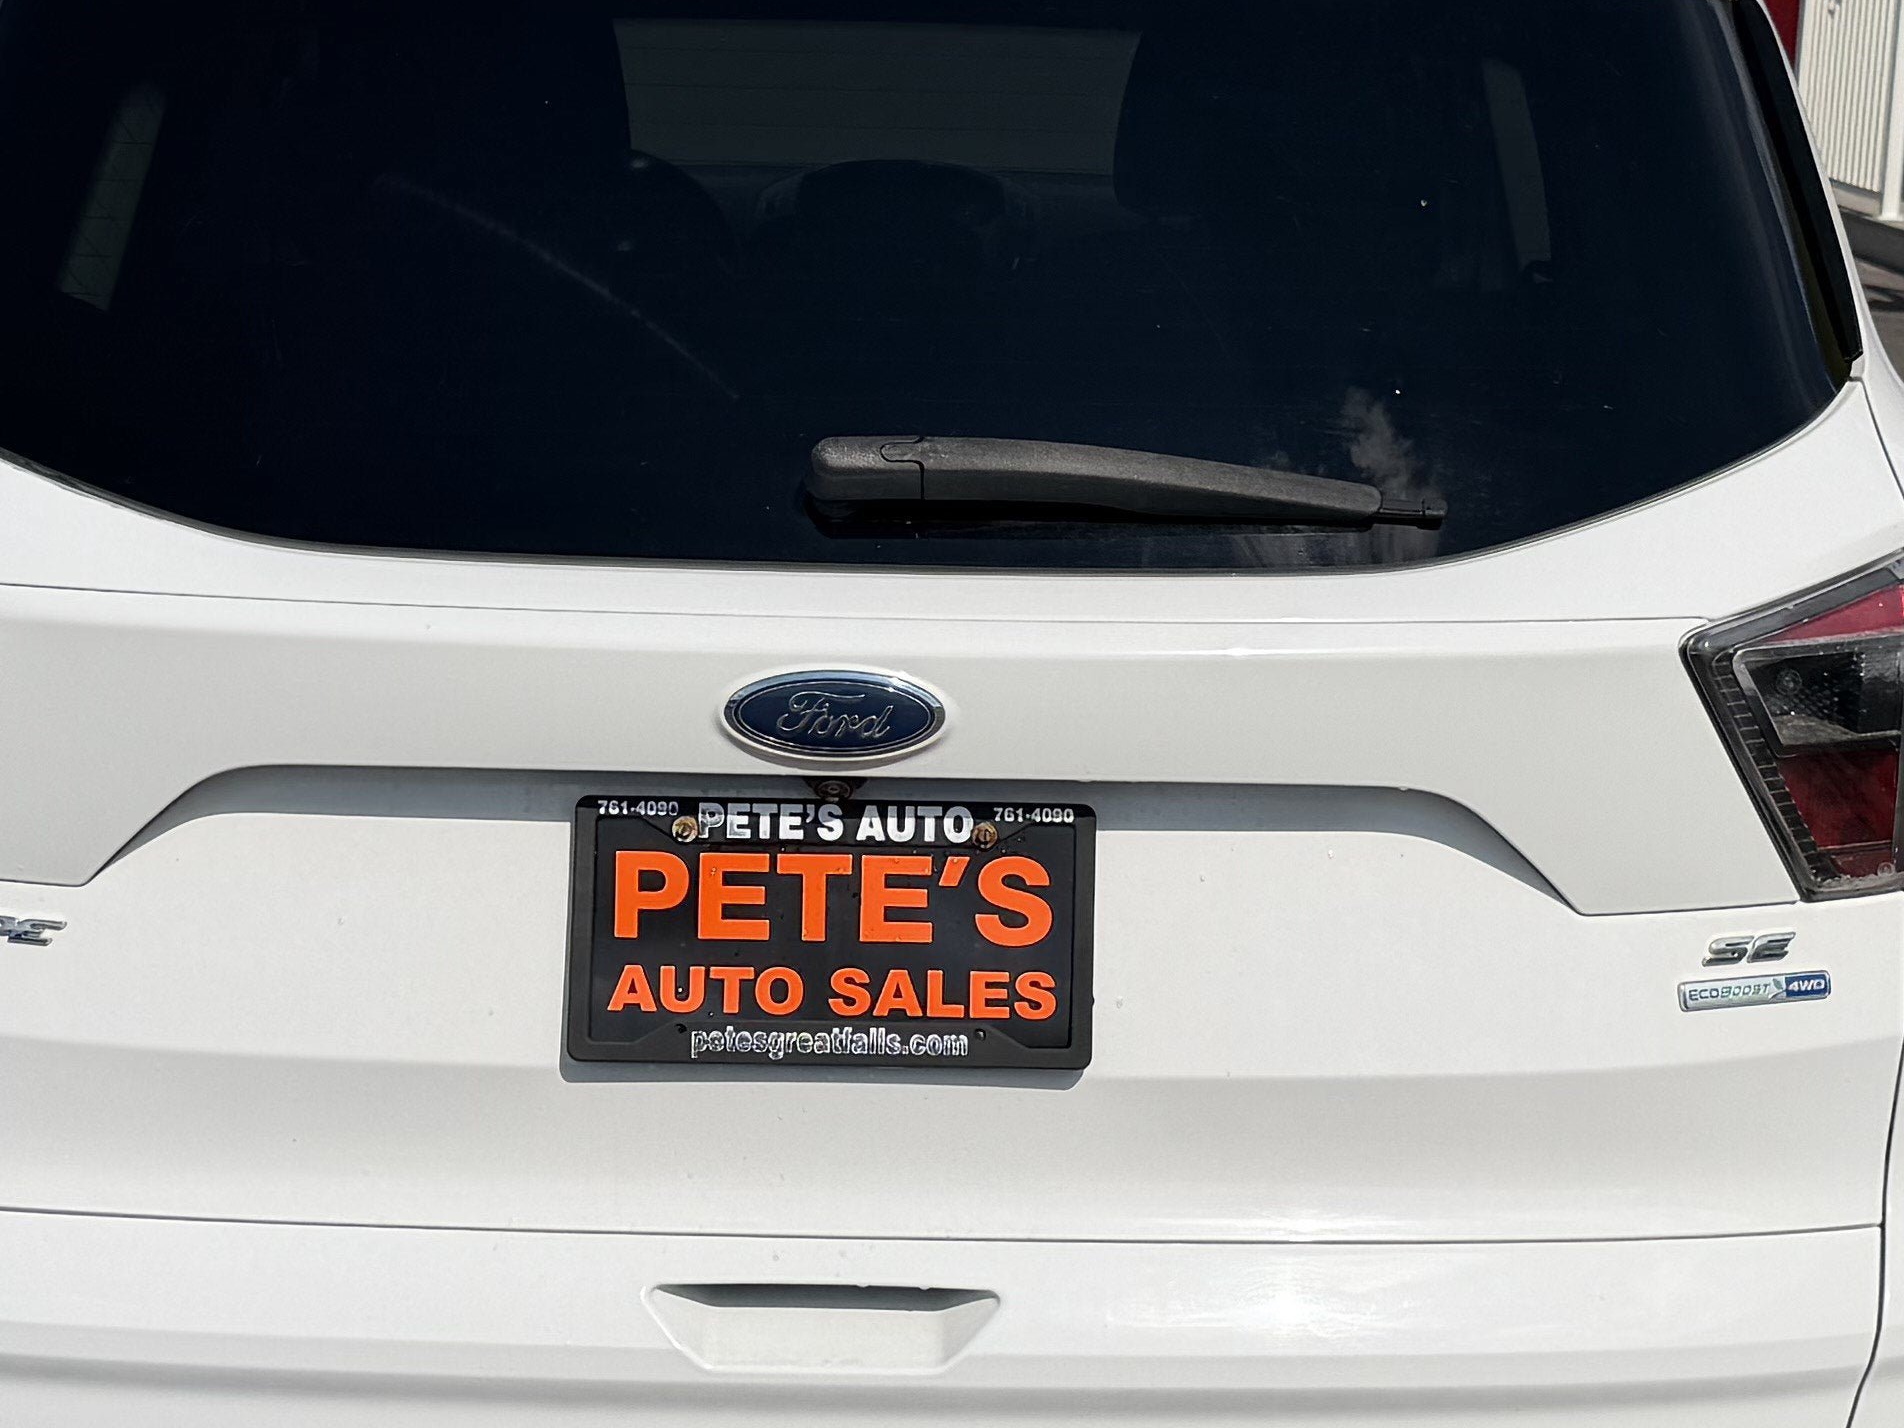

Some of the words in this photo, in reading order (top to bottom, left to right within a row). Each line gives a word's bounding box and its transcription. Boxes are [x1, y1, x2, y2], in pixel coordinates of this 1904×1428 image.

[776, 690, 894, 739] Ford
[597, 799, 679, 817] 761-4090
[697, 801, 844, 842] PETE'S
[855, 804, 974, 844] AUTO
[992, 806, 1075, 824] 761-4090
[613, 850, 1054, 948] PETE'S
[1701, 931, 1796, 967] SE
[607, 964, 805, 1016] AUTO
[828, 967, 1058, 1020] SALES
[1787, 978, 1825, 993] 4WD
[690, 1025, 969, 1060] petesgreatfalls.com
